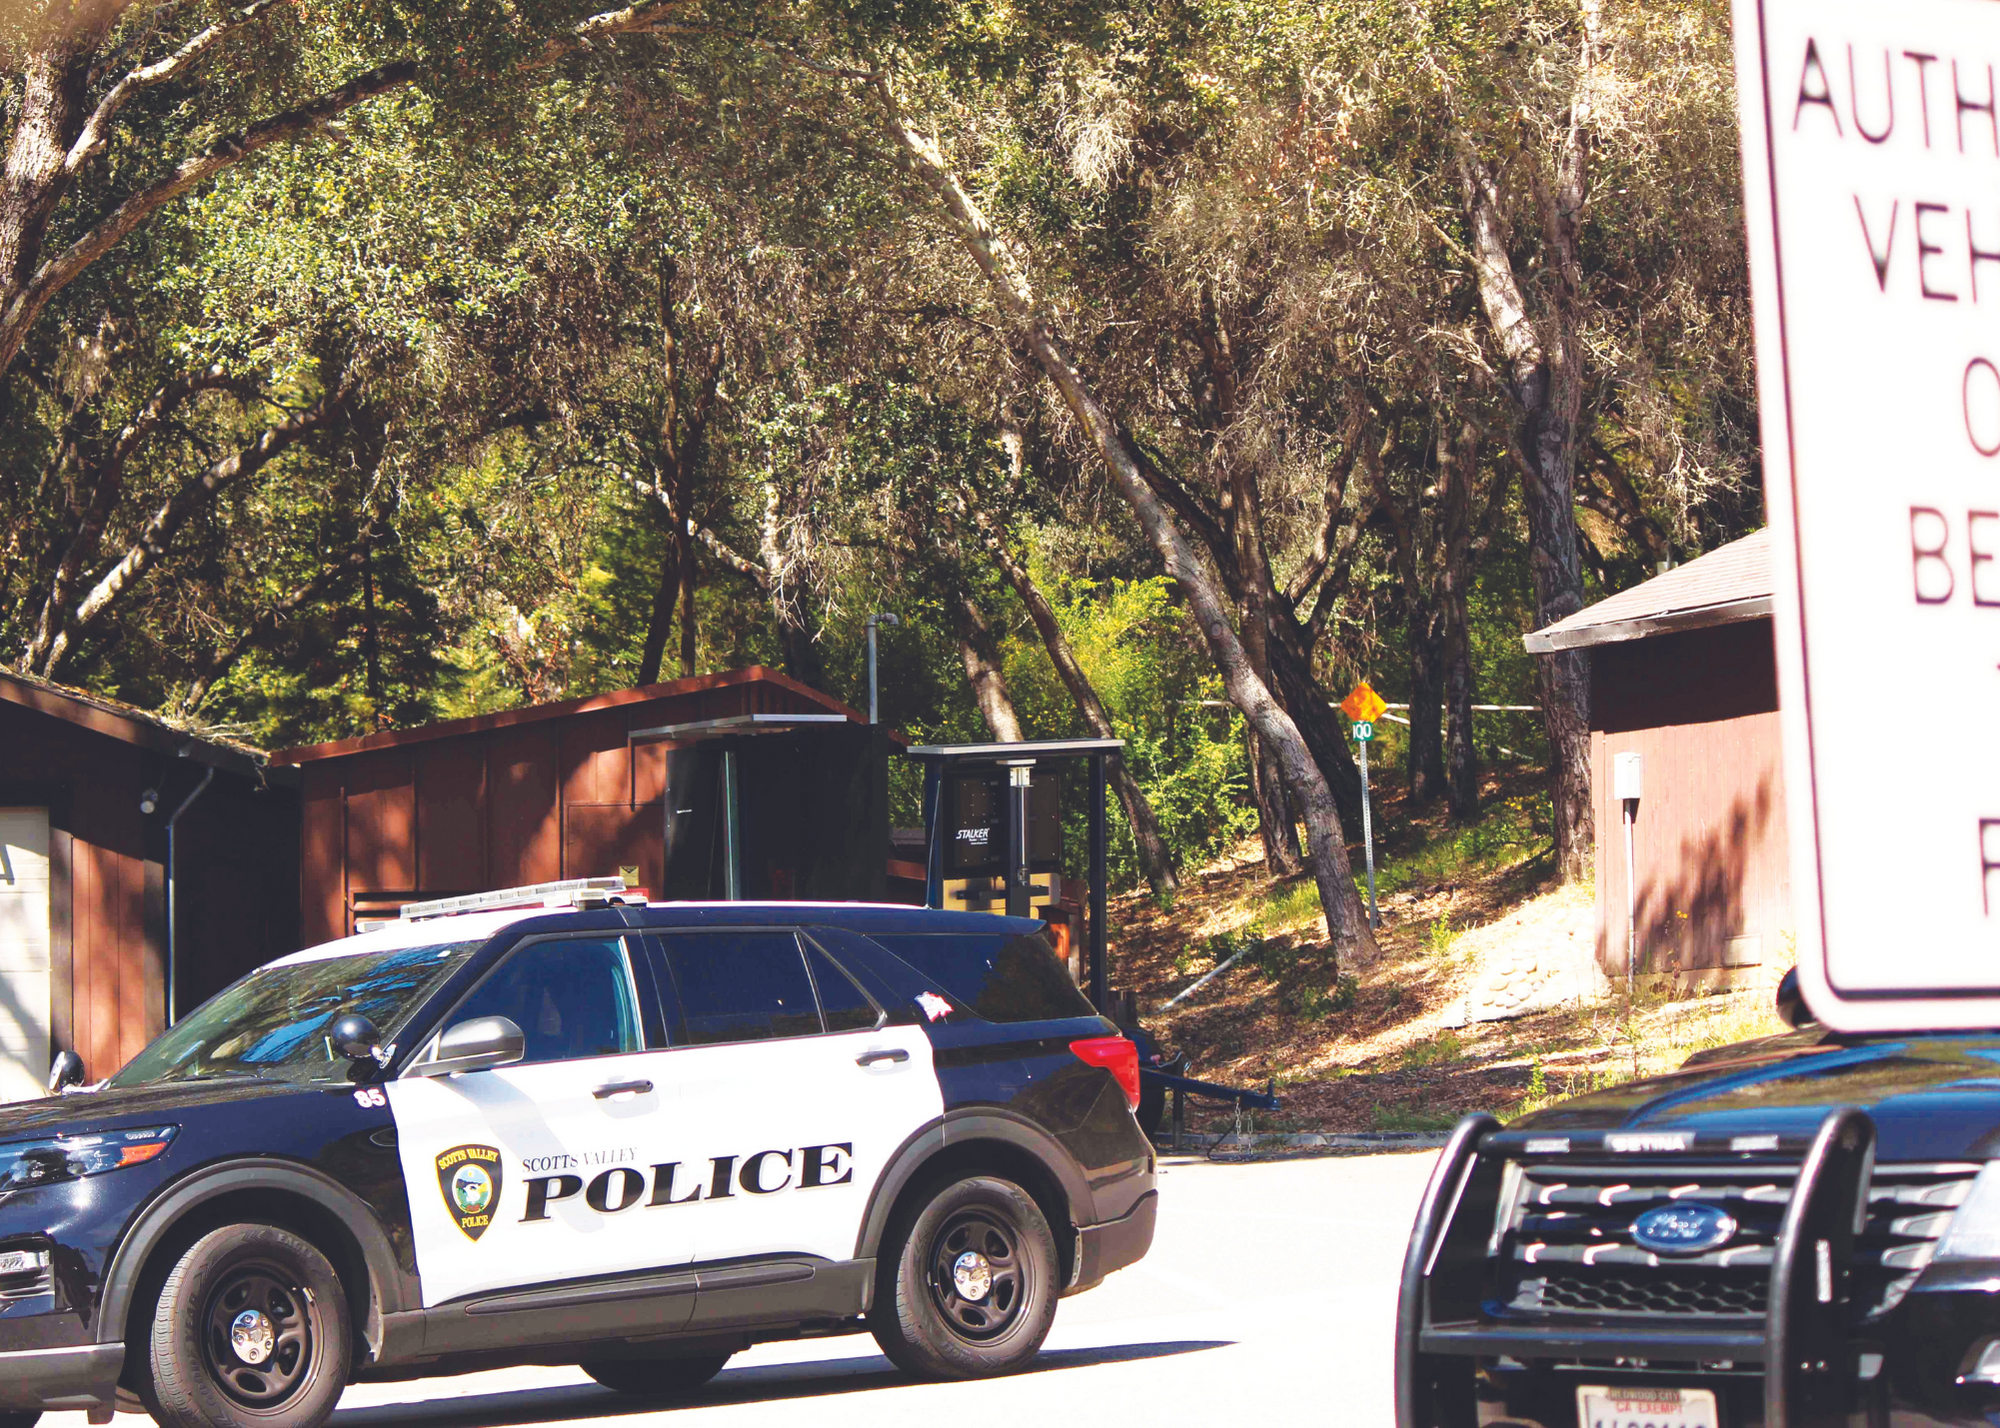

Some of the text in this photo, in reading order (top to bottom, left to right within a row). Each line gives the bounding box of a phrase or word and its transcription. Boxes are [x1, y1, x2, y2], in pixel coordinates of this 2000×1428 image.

[1793, 37, 2000, 157] AUTH
[1353, 724, 1372, 739] 100
[955, 828, 990, 840] STALKER
[353, 1088, 386, 1108] 85
[438, 1147, 499, 1171] SCOTTS VALLEY
[522, 1148, 637, 1173] SCOTTS VALLEY
[517, 1141, 853, 1224] POLICE
[461, 1215, 489, 1229] POLICE
[1615, 1402, 1682, 1415] CA EXEMPT
